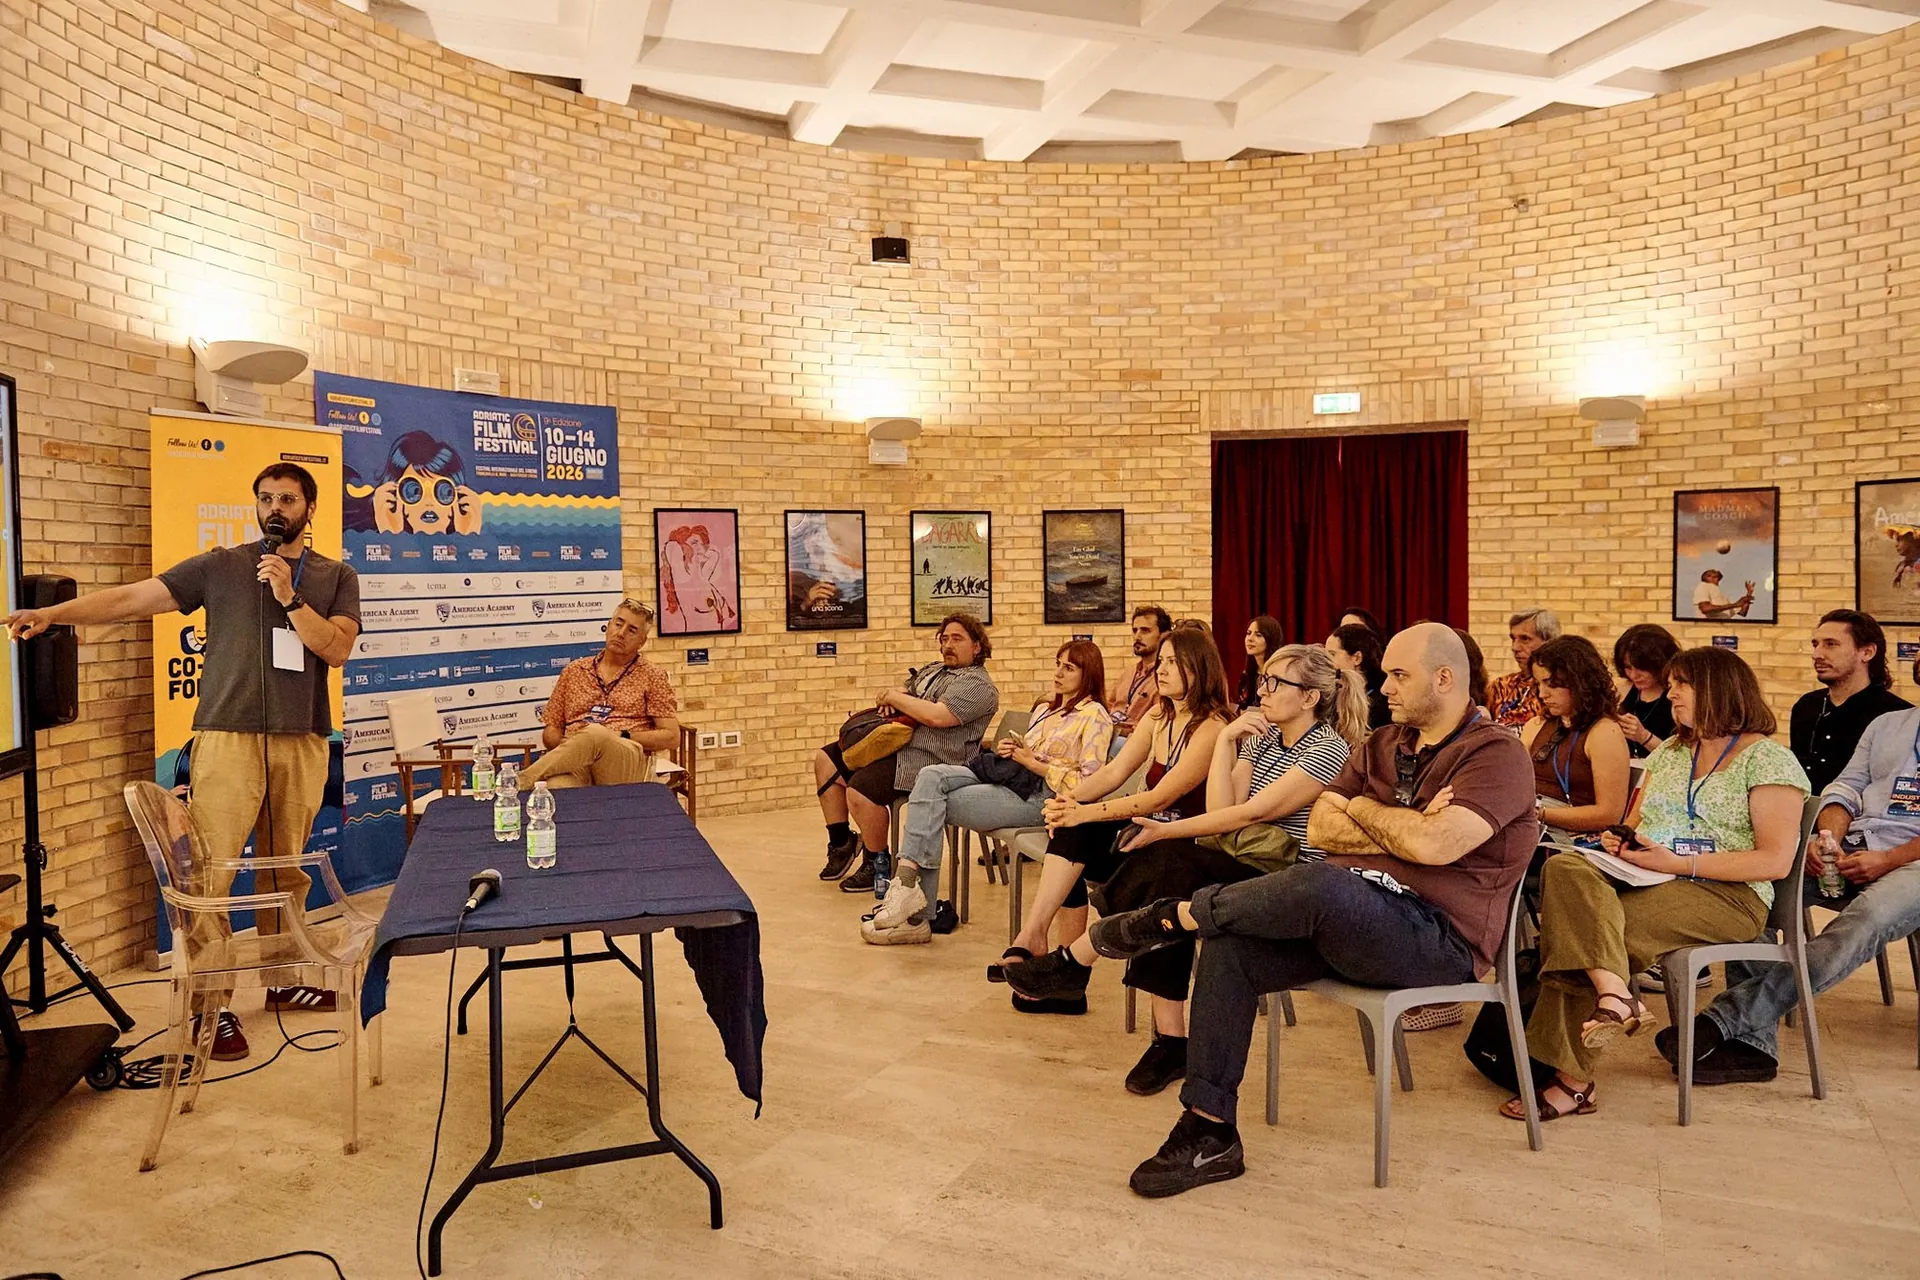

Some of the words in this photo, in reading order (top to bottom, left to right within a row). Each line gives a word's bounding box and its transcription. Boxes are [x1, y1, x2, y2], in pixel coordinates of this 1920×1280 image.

[472, 410, 511, 422] ADRIATIC
[553, 417, 582, 428] Edizione
[473, 420, 512, 439] FILM
[167, 437, 187, 447] Follow
[473, 437, 538, 455] FESTIVAL
[545, 445, 607, 467] GIUGNO
[546, 464, 584, 480] 2026
[198, 503, 258, 520] ADRIAT
[452, 605, 485, 613] AMERICAN
[486, 604, 516, 612] ACADEMY
[576, 600, 603, 608] ACADEMY
[360, 609, 389, 617] ERICAN
[389, 608, 419, 616] ACADEMY
[168, 678, 201, 701] FO
[458, 715, 489, 725] AMERICAN
[490, 711, 518, 721] ACADEMY
[354, 728, 391, 738] AMERICAN
